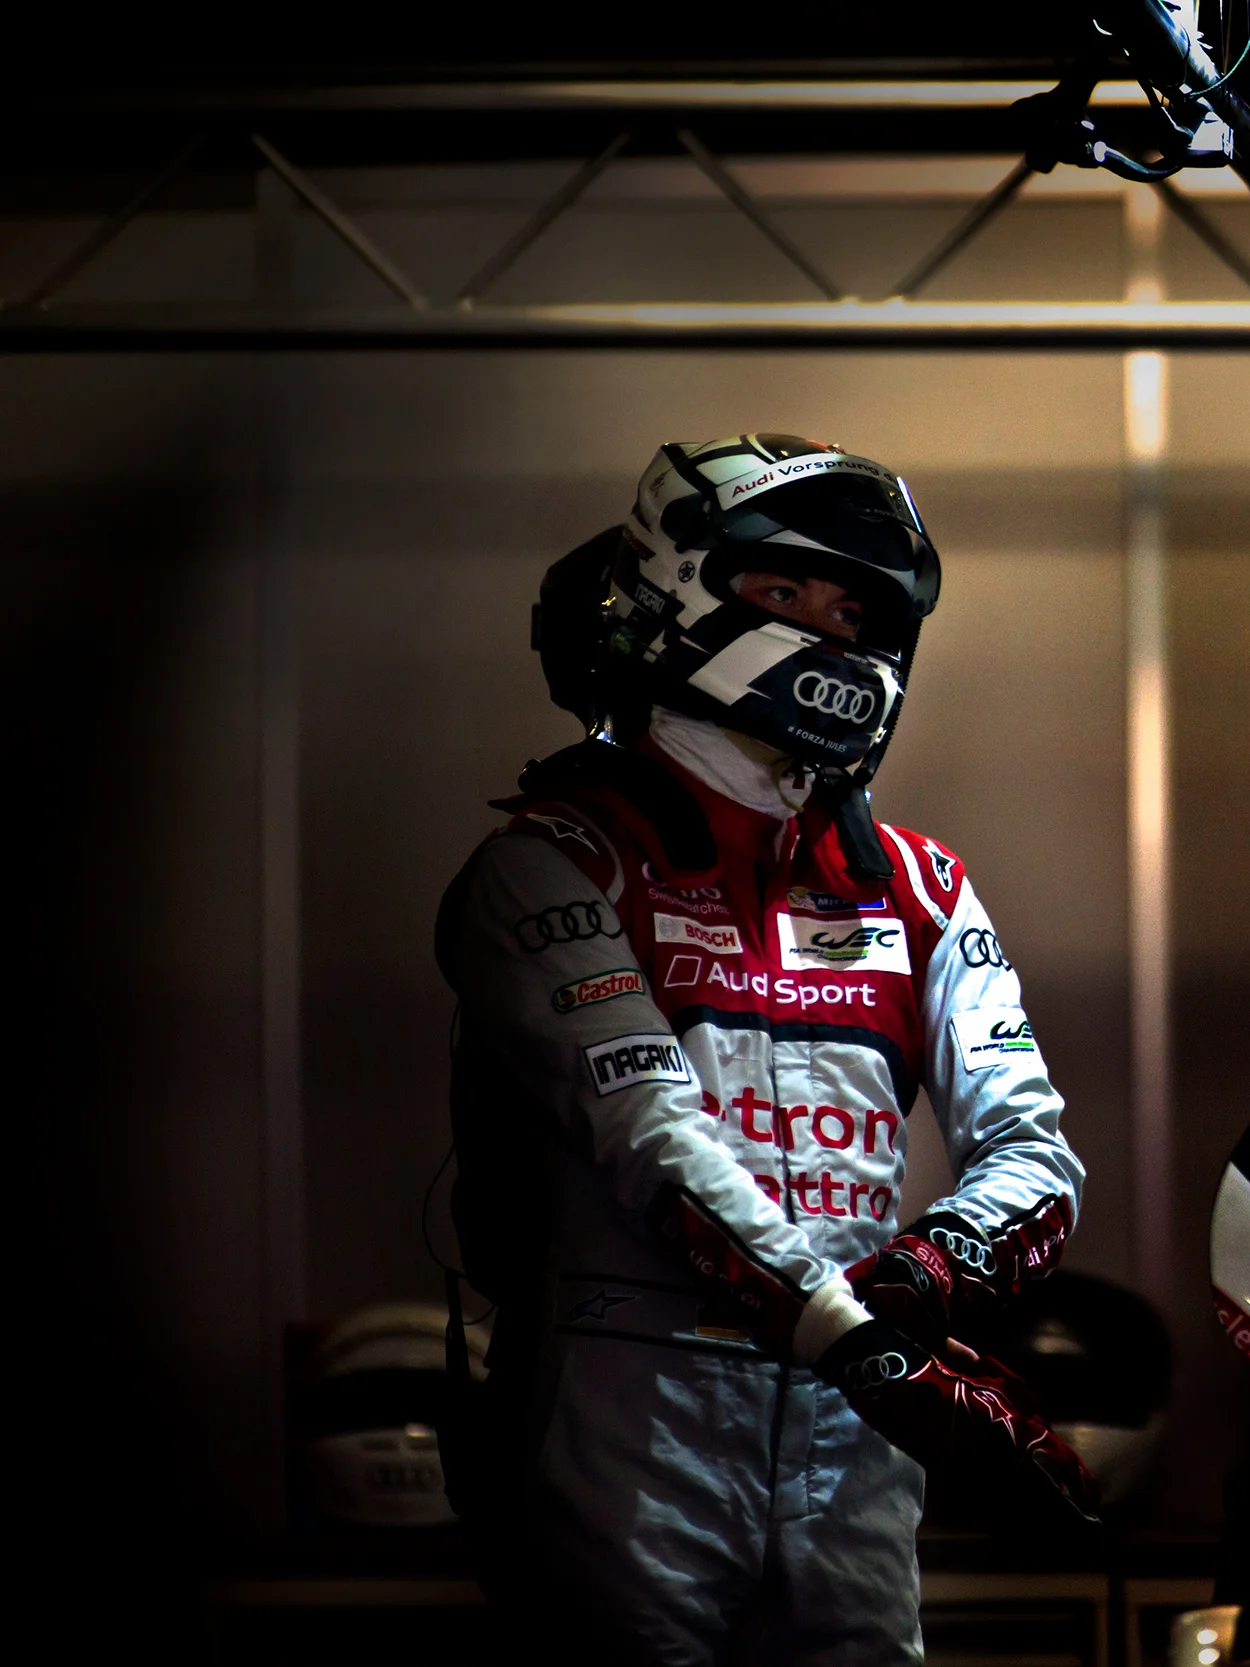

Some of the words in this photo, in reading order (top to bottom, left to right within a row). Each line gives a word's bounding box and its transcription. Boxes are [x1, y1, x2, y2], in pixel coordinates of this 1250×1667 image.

[731, 470, 775, 498] Audi
[778, 458, 880, 477] Vorsprung
[796, 728, 825, 746] FORZA
[825, 740, 848, 753] JULES
[685, 924, 736, 947] BOSCH
[811, 927, 900, 949] WEC
[577, 973, 642, 1003] Castrol
[706, 961, 769, 998] Aud
[773, 979, 877, 1010] Sport
[989, 1020, 1033, 1040] WE
[592, 1044, 683, 1085] INAGAKI
